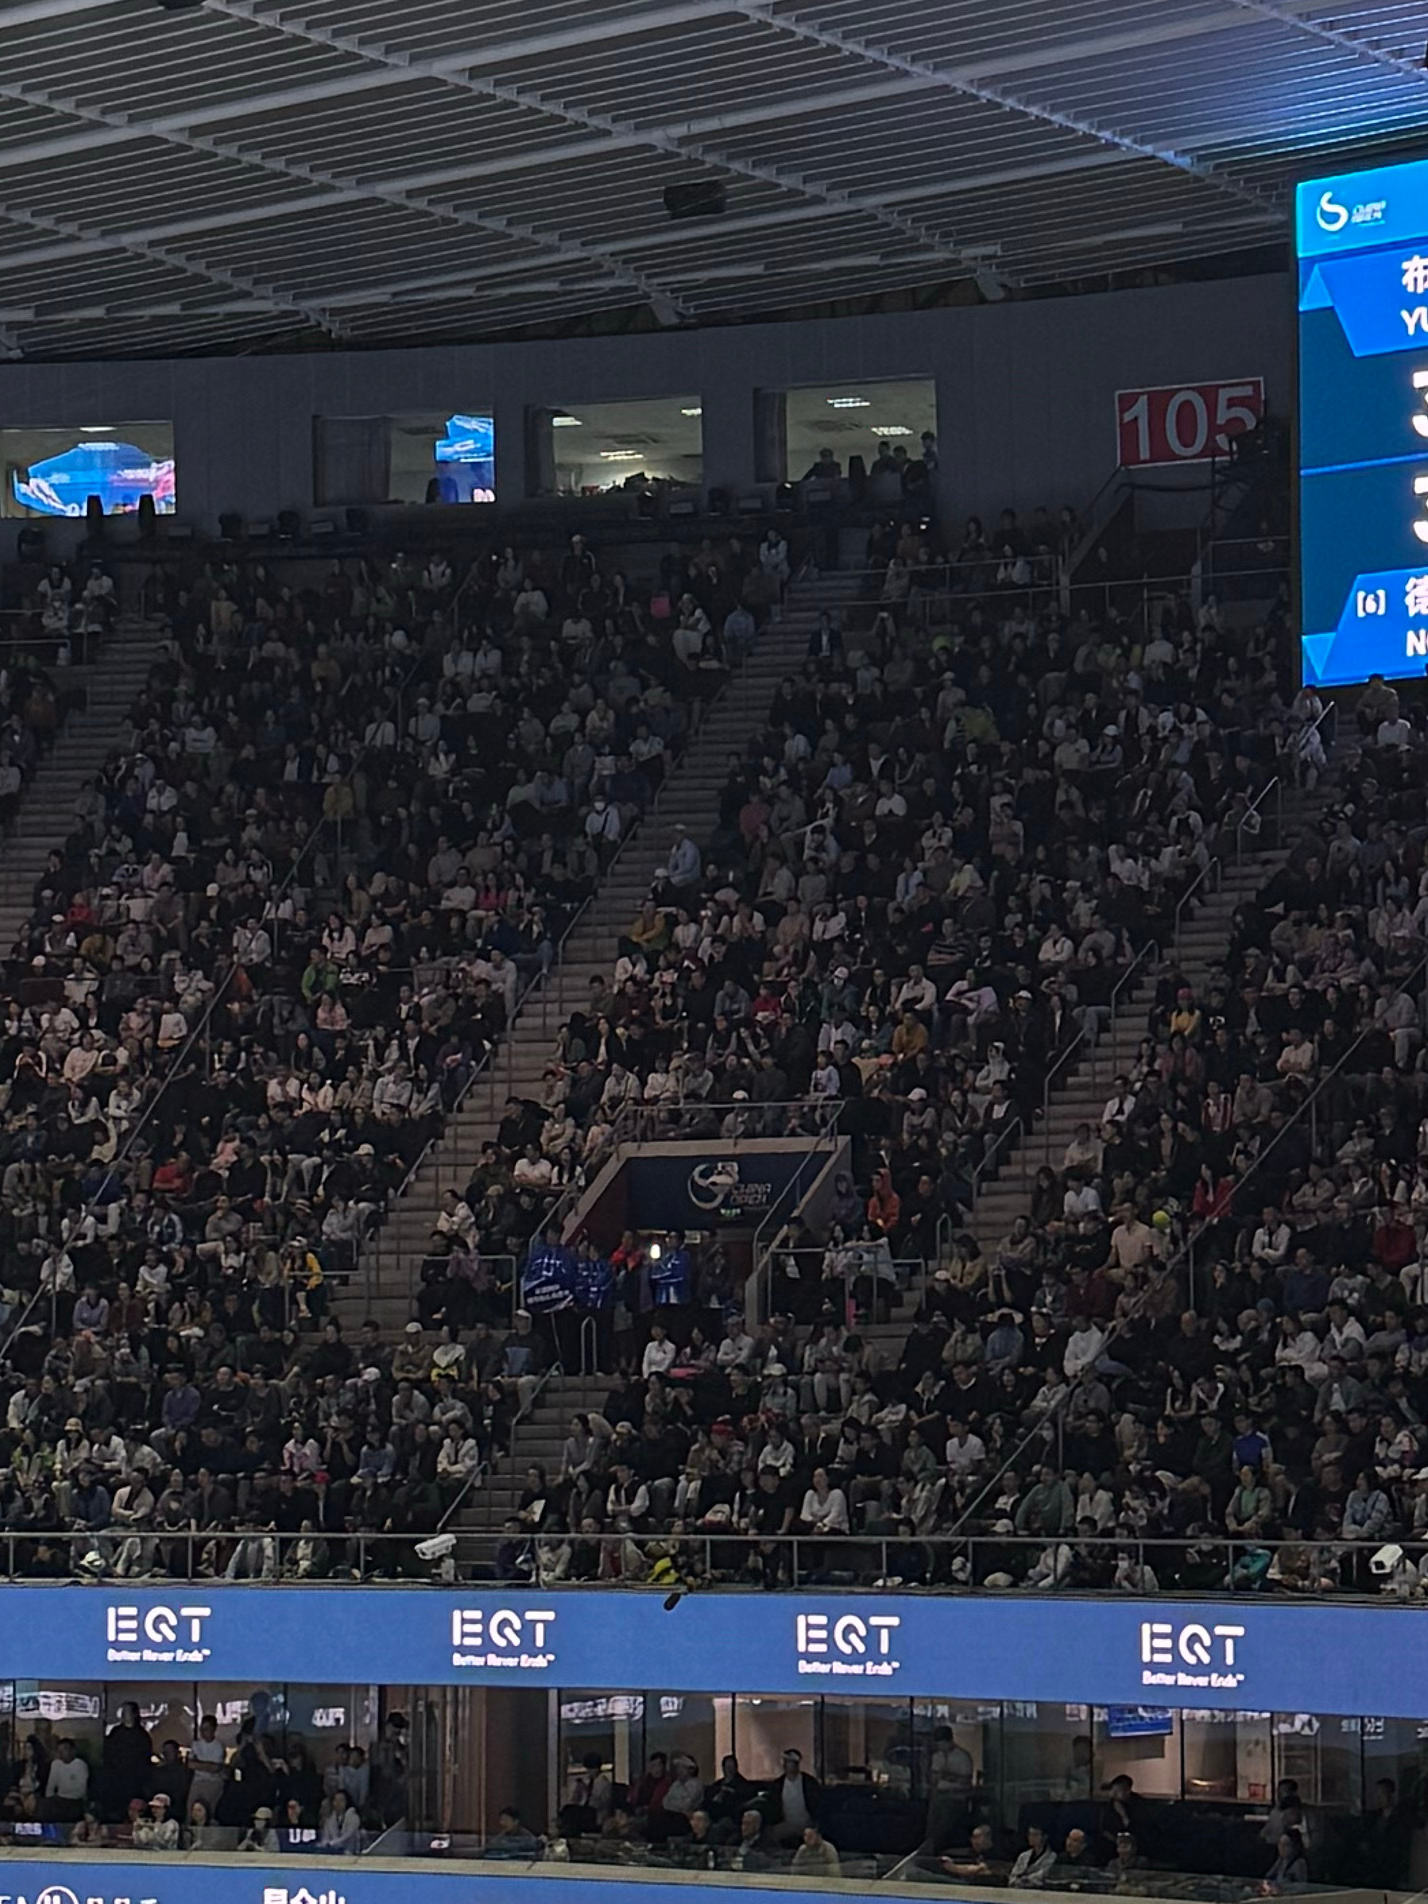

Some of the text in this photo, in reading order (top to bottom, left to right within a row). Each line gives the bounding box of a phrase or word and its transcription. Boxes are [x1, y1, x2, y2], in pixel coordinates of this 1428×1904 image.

[1122, 384, 1258, 462] 105
[107, 1606, 212, 1643] EQT
[452, 1609, 556, 1648] EQT
[796, 1614, 901, 1655] EQT
[1141, 1622, 1245, 1666] EQT
